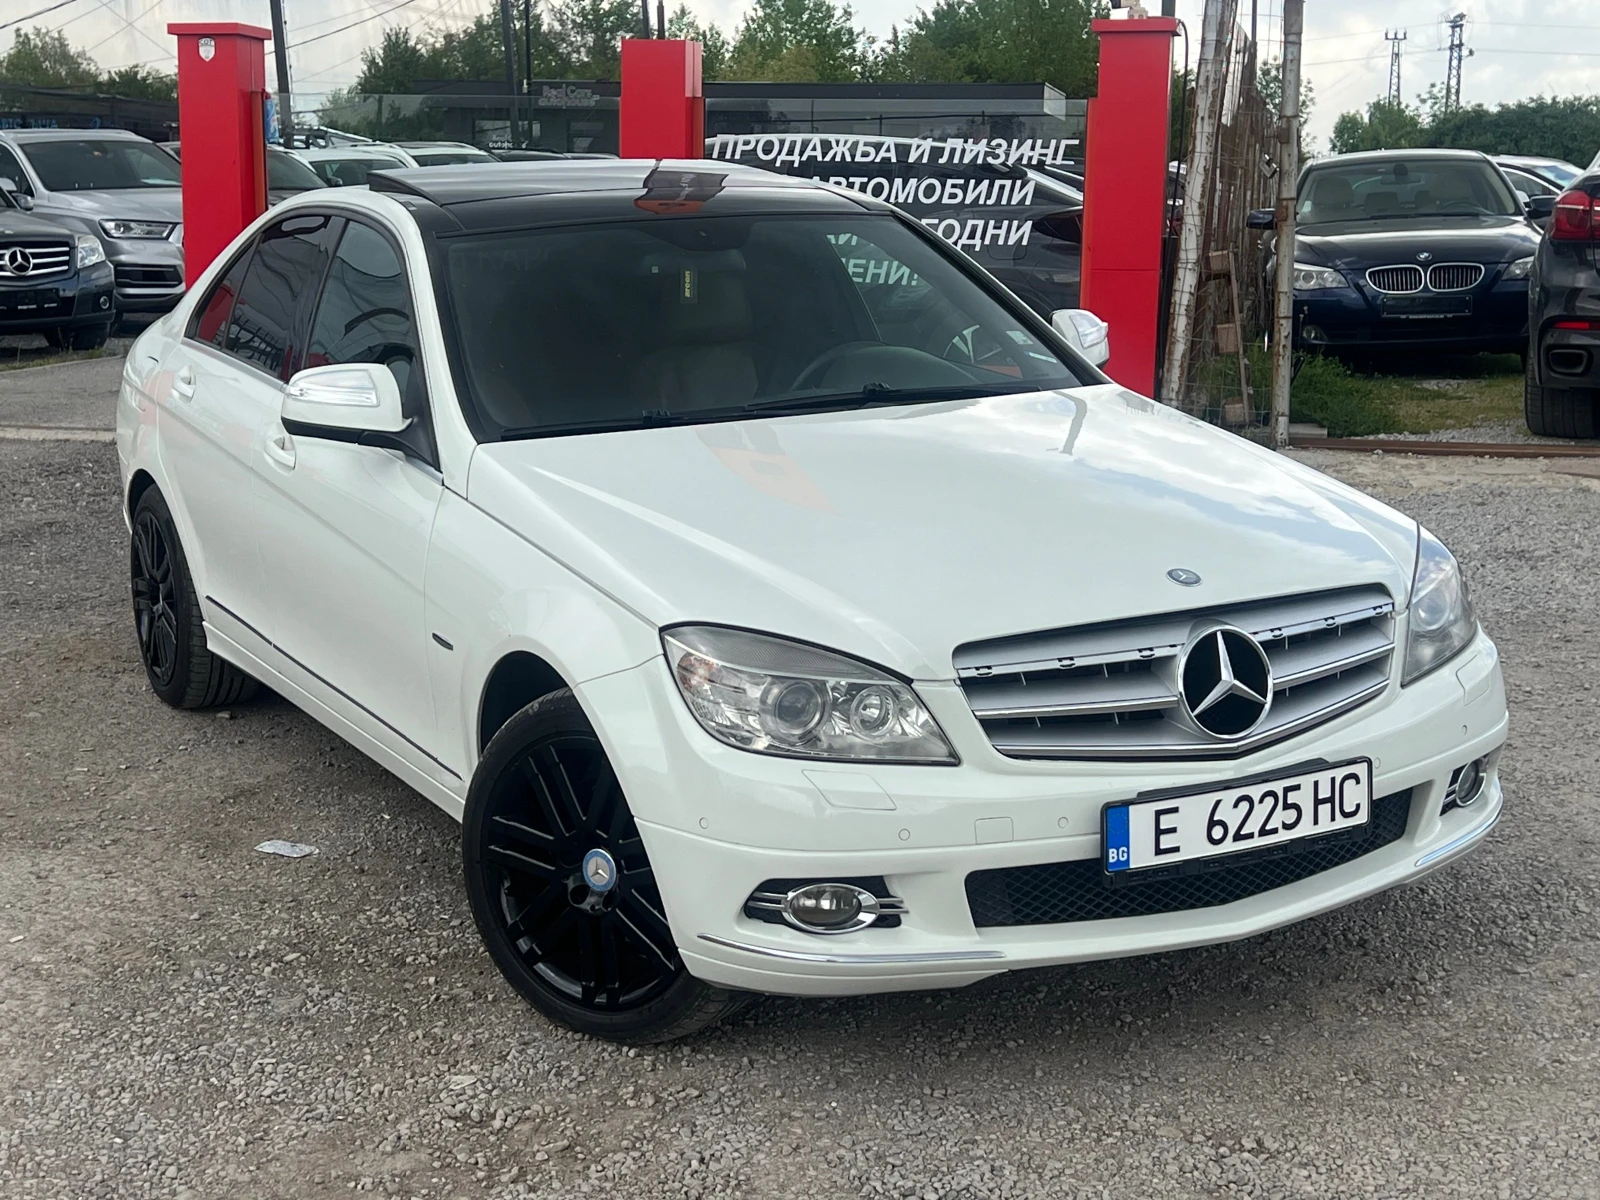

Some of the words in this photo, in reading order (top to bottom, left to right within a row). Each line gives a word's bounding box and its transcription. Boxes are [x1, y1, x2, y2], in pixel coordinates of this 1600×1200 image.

[712, 134, 897, 167] ПРОДАЖБА
[908, 138, 933, 163] И
[938, 138, 1080, 165] ЛИЗИНГ
[841, 257, 918, 286] ЕНИ!
[1154, 806, 1181, 856] E
[1206, 784, 1303, 846] 6225
[1313, 772, 1361, 826] HC
[1108, 847, 1128, 862] BG
